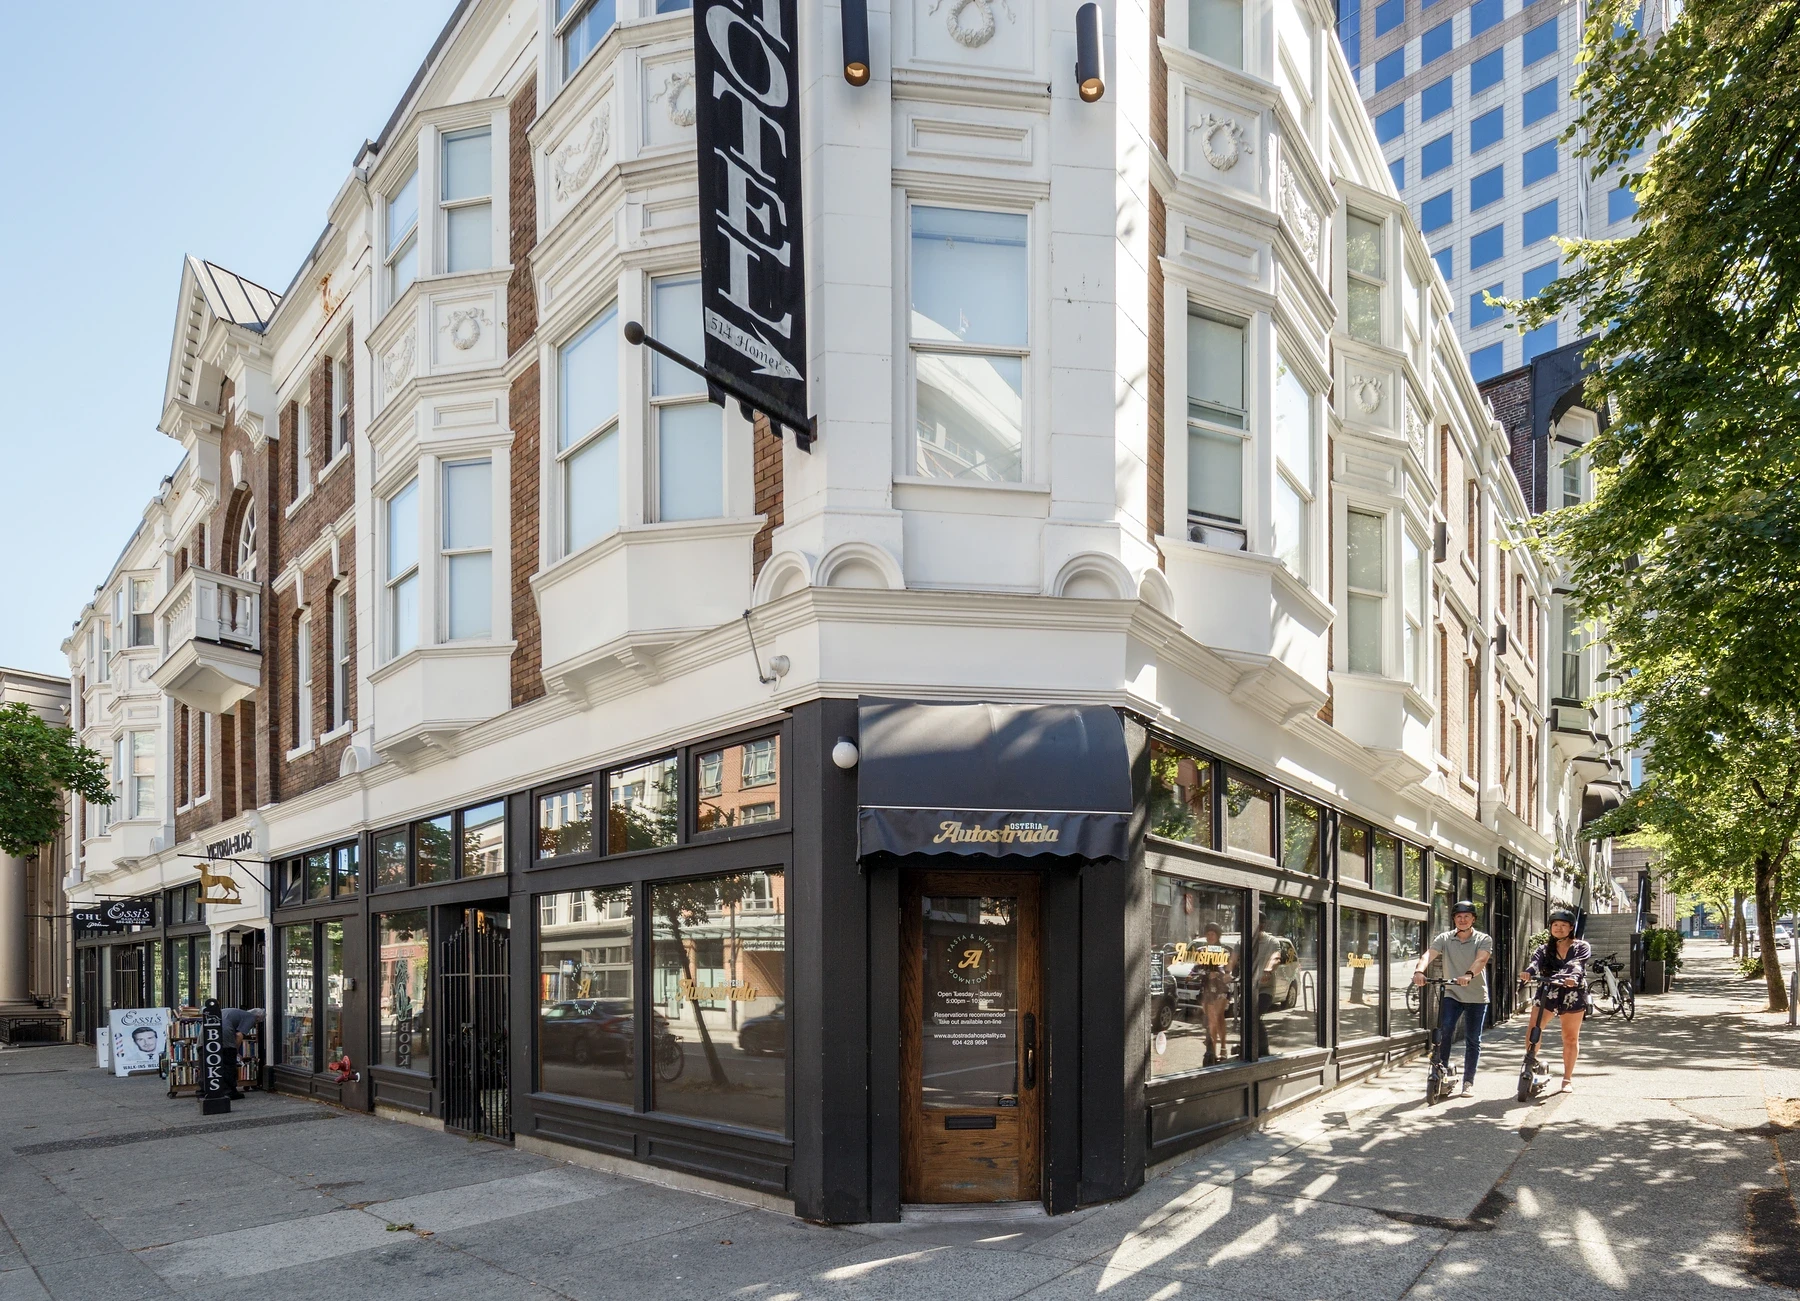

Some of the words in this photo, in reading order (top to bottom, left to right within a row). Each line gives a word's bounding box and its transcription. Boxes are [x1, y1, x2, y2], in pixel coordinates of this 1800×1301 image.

[711, 317, 732, 340] 514
[735, 335, 782, 370] Homer
[933, 820, 1059, 844] Autostrada
[1010, 822, 1043, 830] OSTERIA
[107, 902, 150, 919] Essi's
[947, 935, 967, 952] PASTA
[978, 936, 995, 953] WINE
[1172, 942, 1229, 966] Autostrada
[957, 949, 983, 969] A
[949, 969, 992, 984] DOWNTOWN
[577, 978, 592, 998] A
[675, 979, 757, 1002] Autostrada
[573, 999, 597, 1015] DOWNTOWN
[205, 1028, 222, 1091] BOOKS
